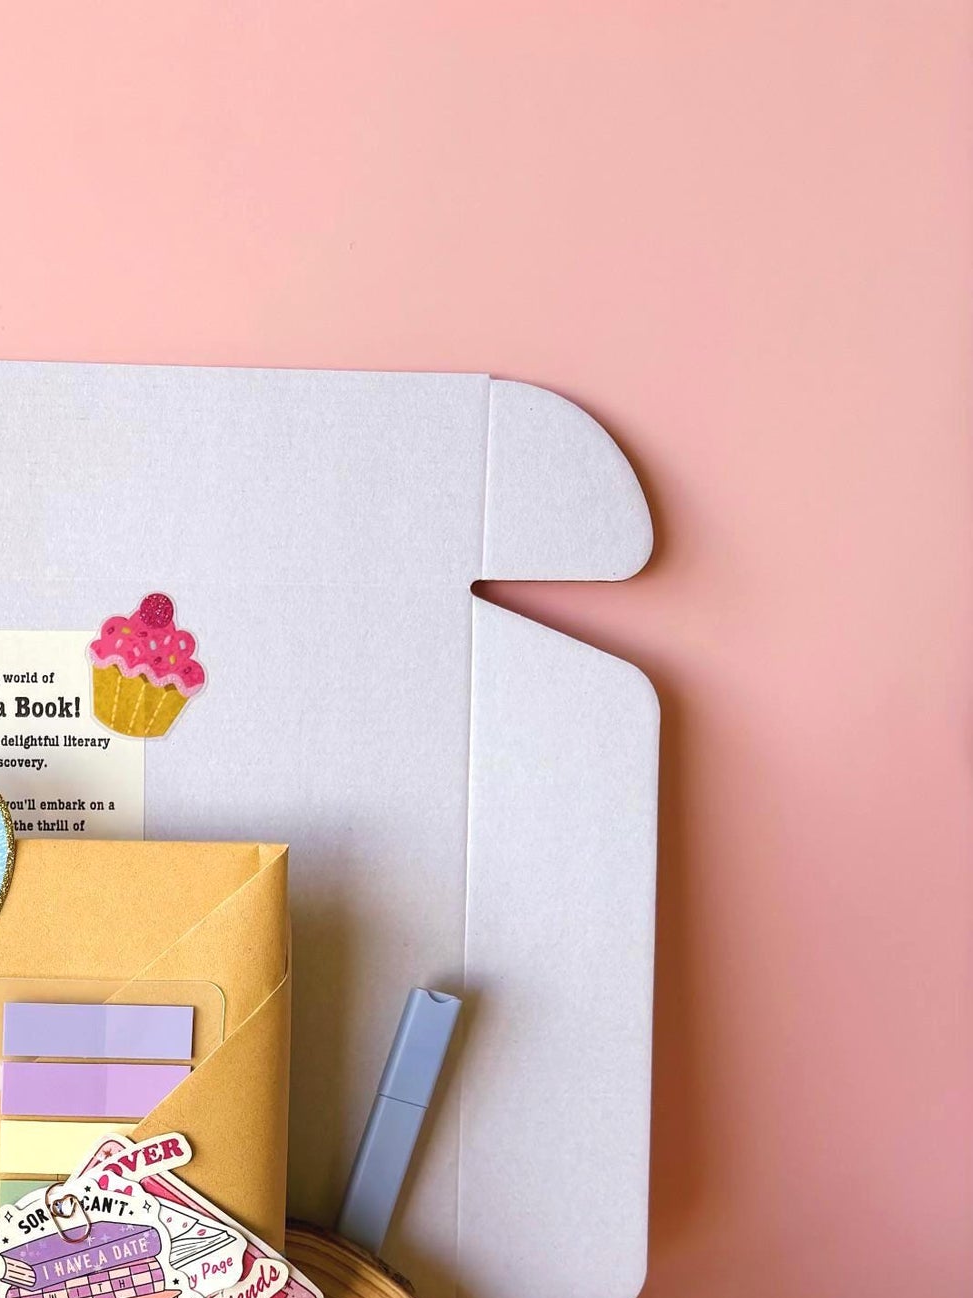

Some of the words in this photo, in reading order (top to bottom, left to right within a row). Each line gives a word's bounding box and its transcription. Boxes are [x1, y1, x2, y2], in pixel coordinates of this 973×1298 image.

[2, 671, 38, 684] world
[42, 671, 55, 684] of
[14, 696, 81, 718] Book!
[0, 734, 60, 750] delightful
[63, 734, 111, 750] literary
[6, 798, 36, 811] ou'll
[39, 798, 86, 811] embark
[89, 801, 105, 811] on
[108, 801, 115, 811] a
[13, 819, 34, 832] the
[36, 819, 69, 832] thrill
[72, 819, 86, 832] of
[80, 1195, 129, 1217] CAN'T
[42, 1265, 50, 1281] I
[53, 1253, 92, 1278] HAVE
[98, 1251, 108, 1266] A
[113, 1237, 149, 1261] DATE
[201, 1257, 234, 1280] Page
